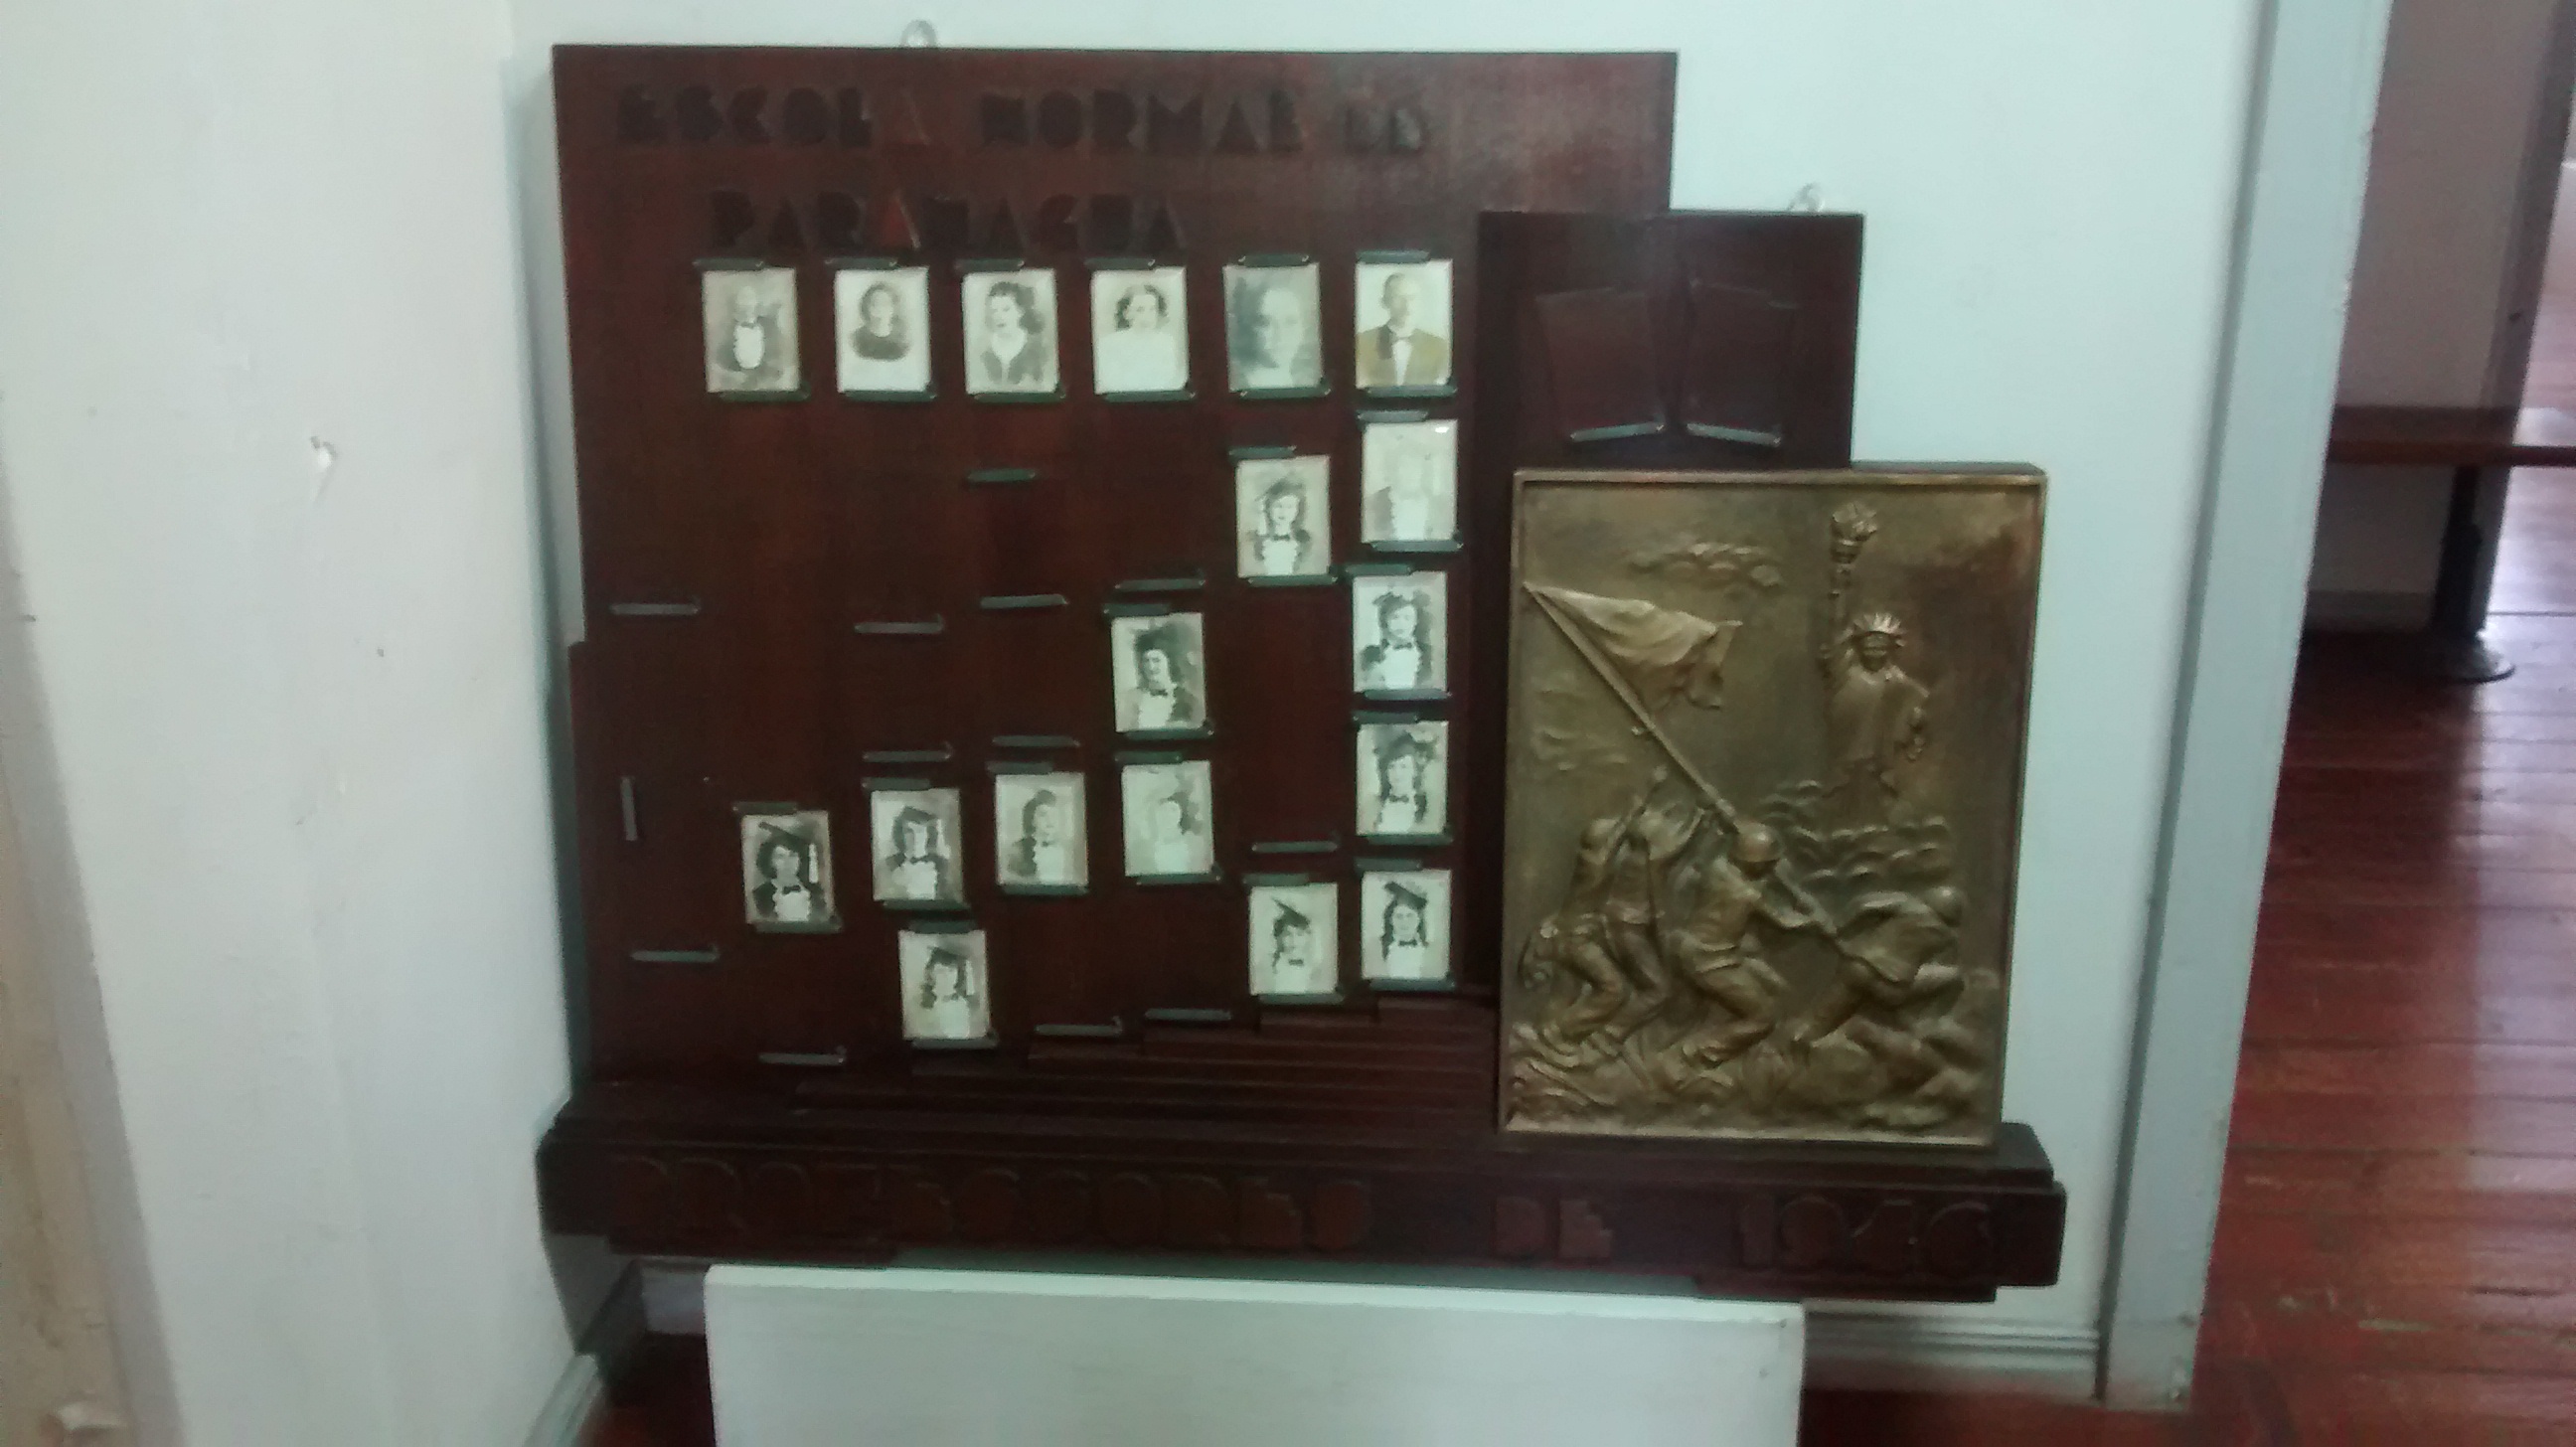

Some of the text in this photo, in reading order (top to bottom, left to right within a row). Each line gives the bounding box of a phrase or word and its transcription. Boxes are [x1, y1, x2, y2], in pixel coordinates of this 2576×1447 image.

[617, 83, 932, 148] ESCOLA
[978, 86, 1303, 158] NORMAL
[1495, 1195, 1614, 1258] DE
